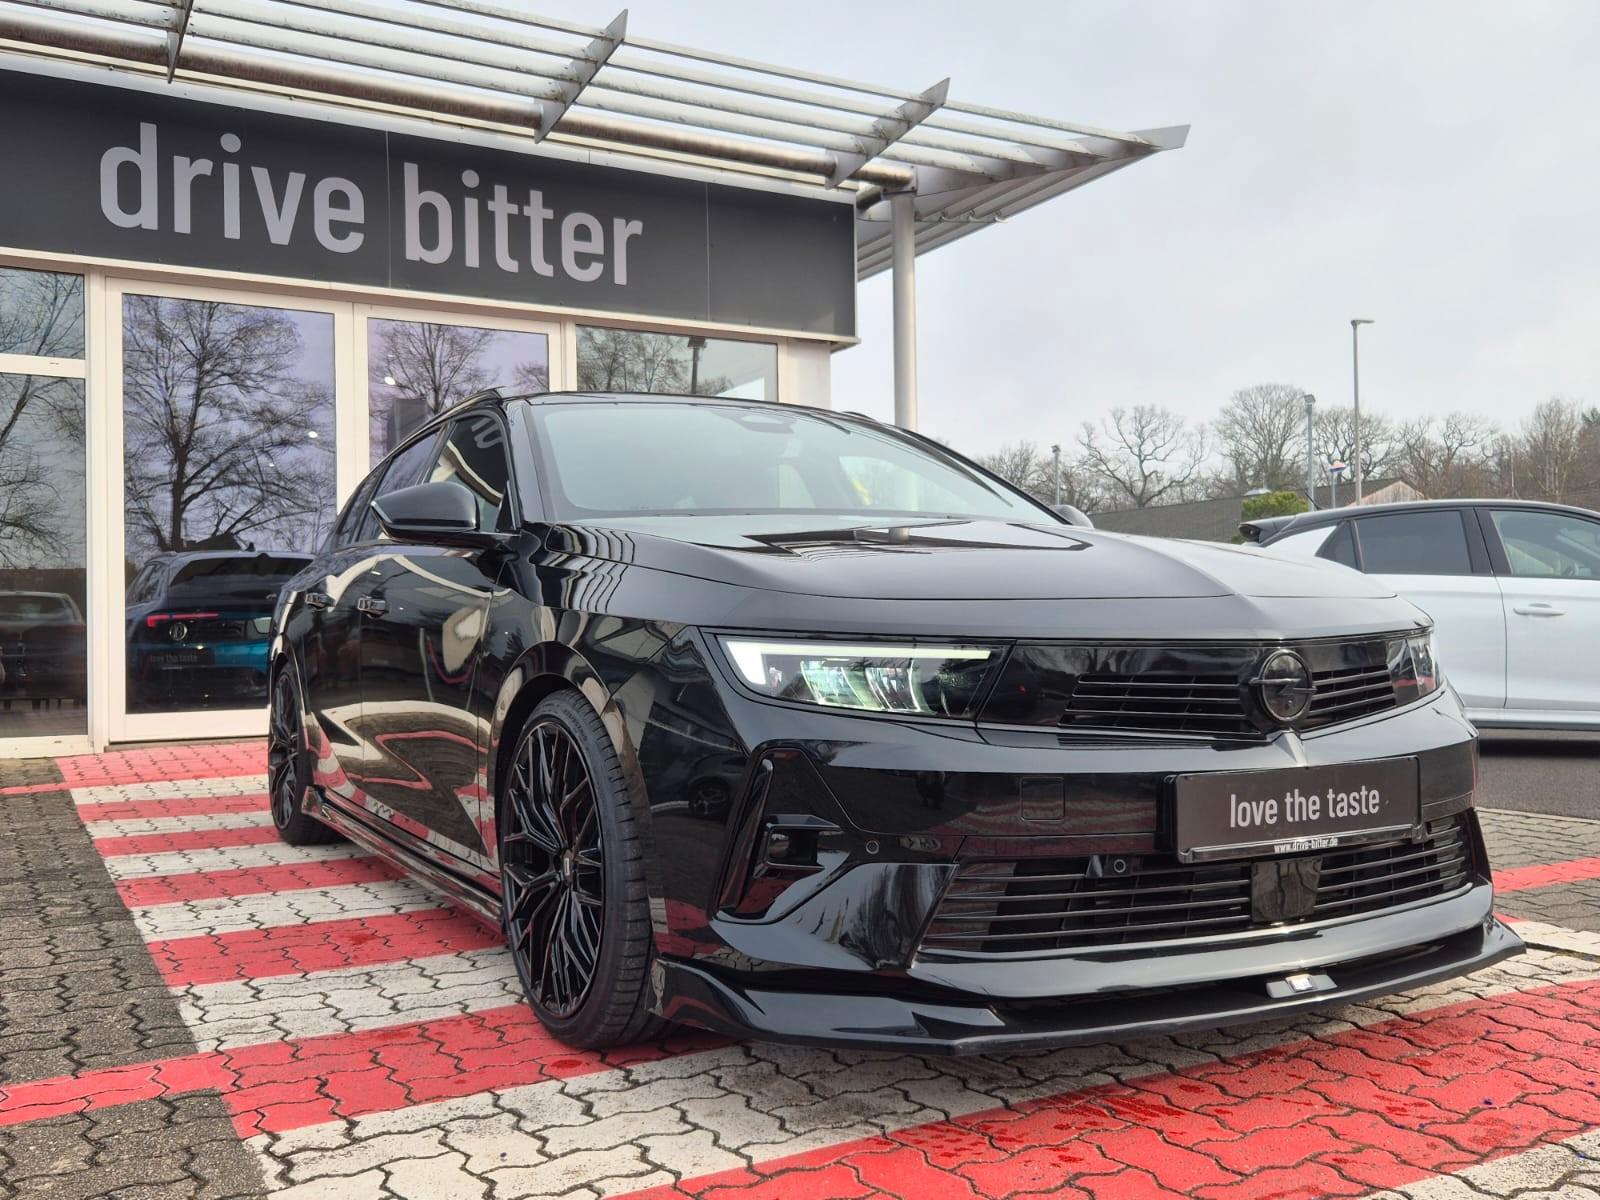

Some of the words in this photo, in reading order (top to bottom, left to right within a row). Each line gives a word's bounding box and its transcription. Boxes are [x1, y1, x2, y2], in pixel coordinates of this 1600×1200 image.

[100, 121, 365, 254] drive
[403, 161, 643, 286] bitter
[1230, 793, 1278, 828] love
[1285, 788, 1320, 823] the
[1327, 785, 1380, 818] taste
